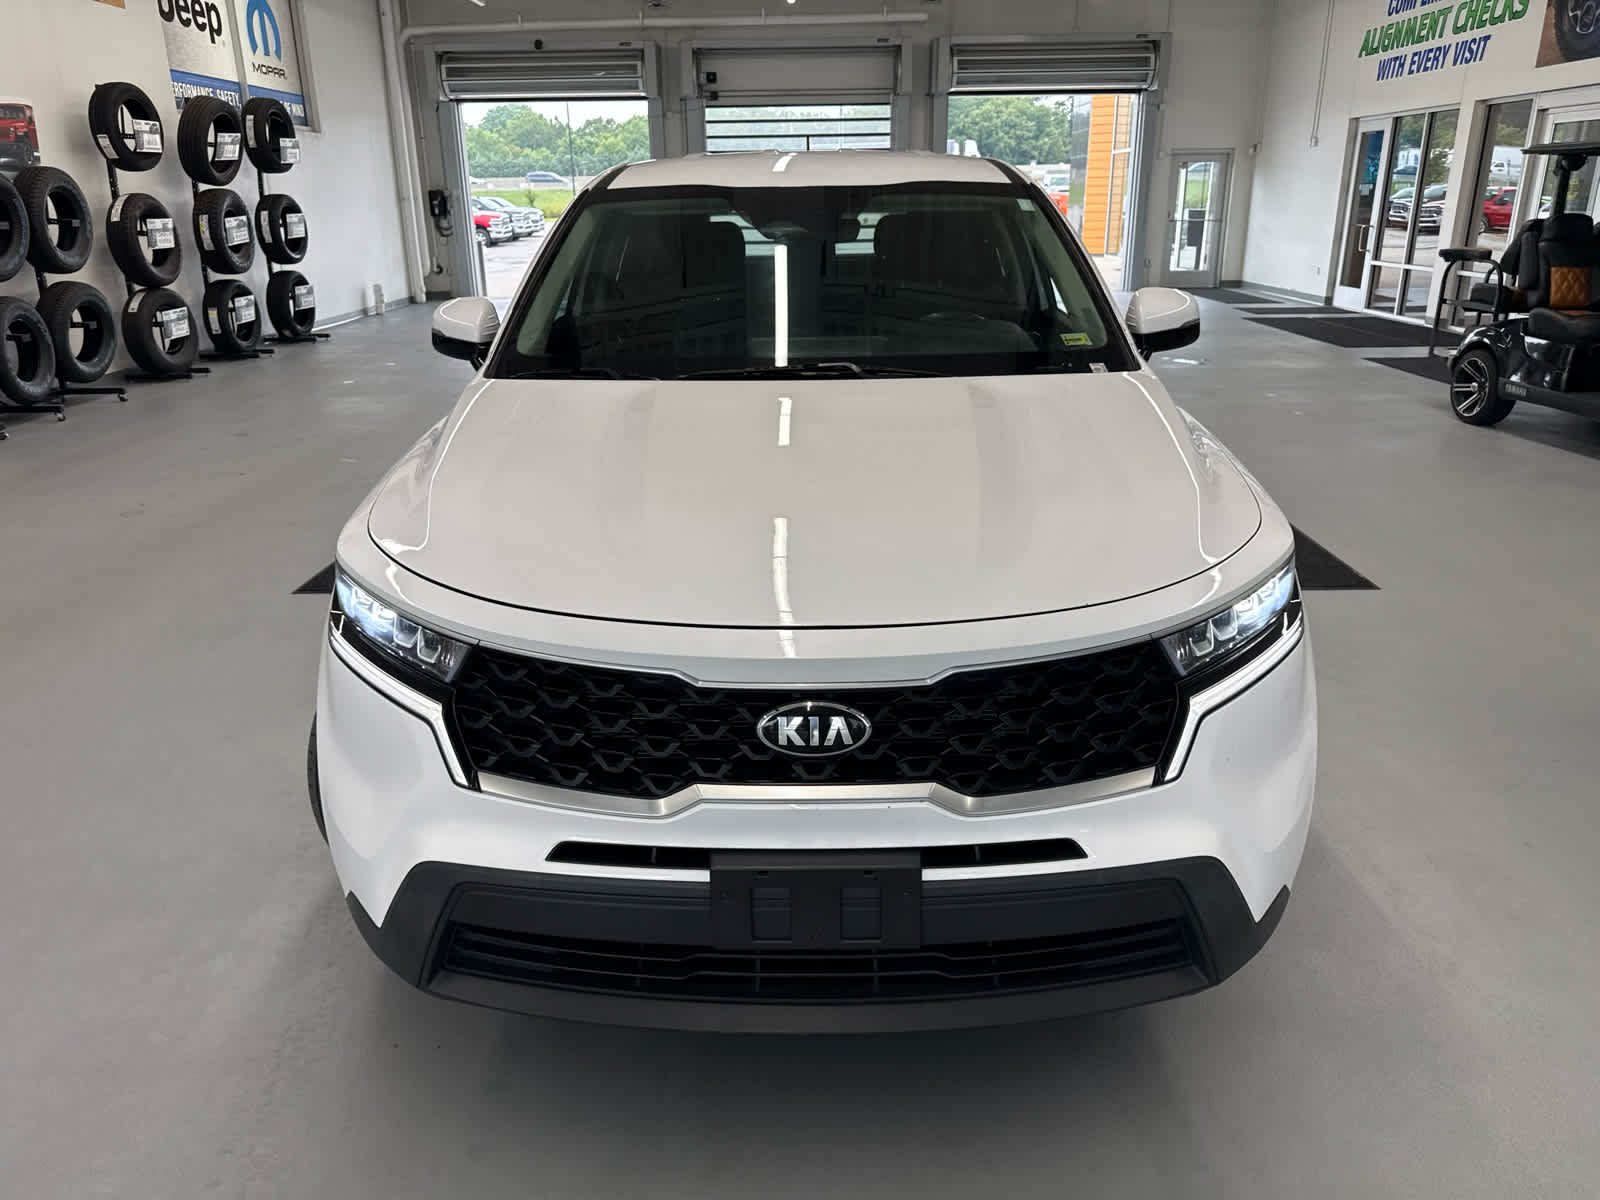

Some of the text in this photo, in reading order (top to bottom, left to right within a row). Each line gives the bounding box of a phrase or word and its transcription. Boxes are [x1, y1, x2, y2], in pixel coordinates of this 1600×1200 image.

[158, 0, 223, 44] Jeep
[1358, 0, 1529, 58] ALIGNMENT CHECKS
[252, 62, 286, 79] MOPAR
[1376, 34, 1491, 81] WITH EVERY VISIT
[777, 716, 854, 746] KIA
